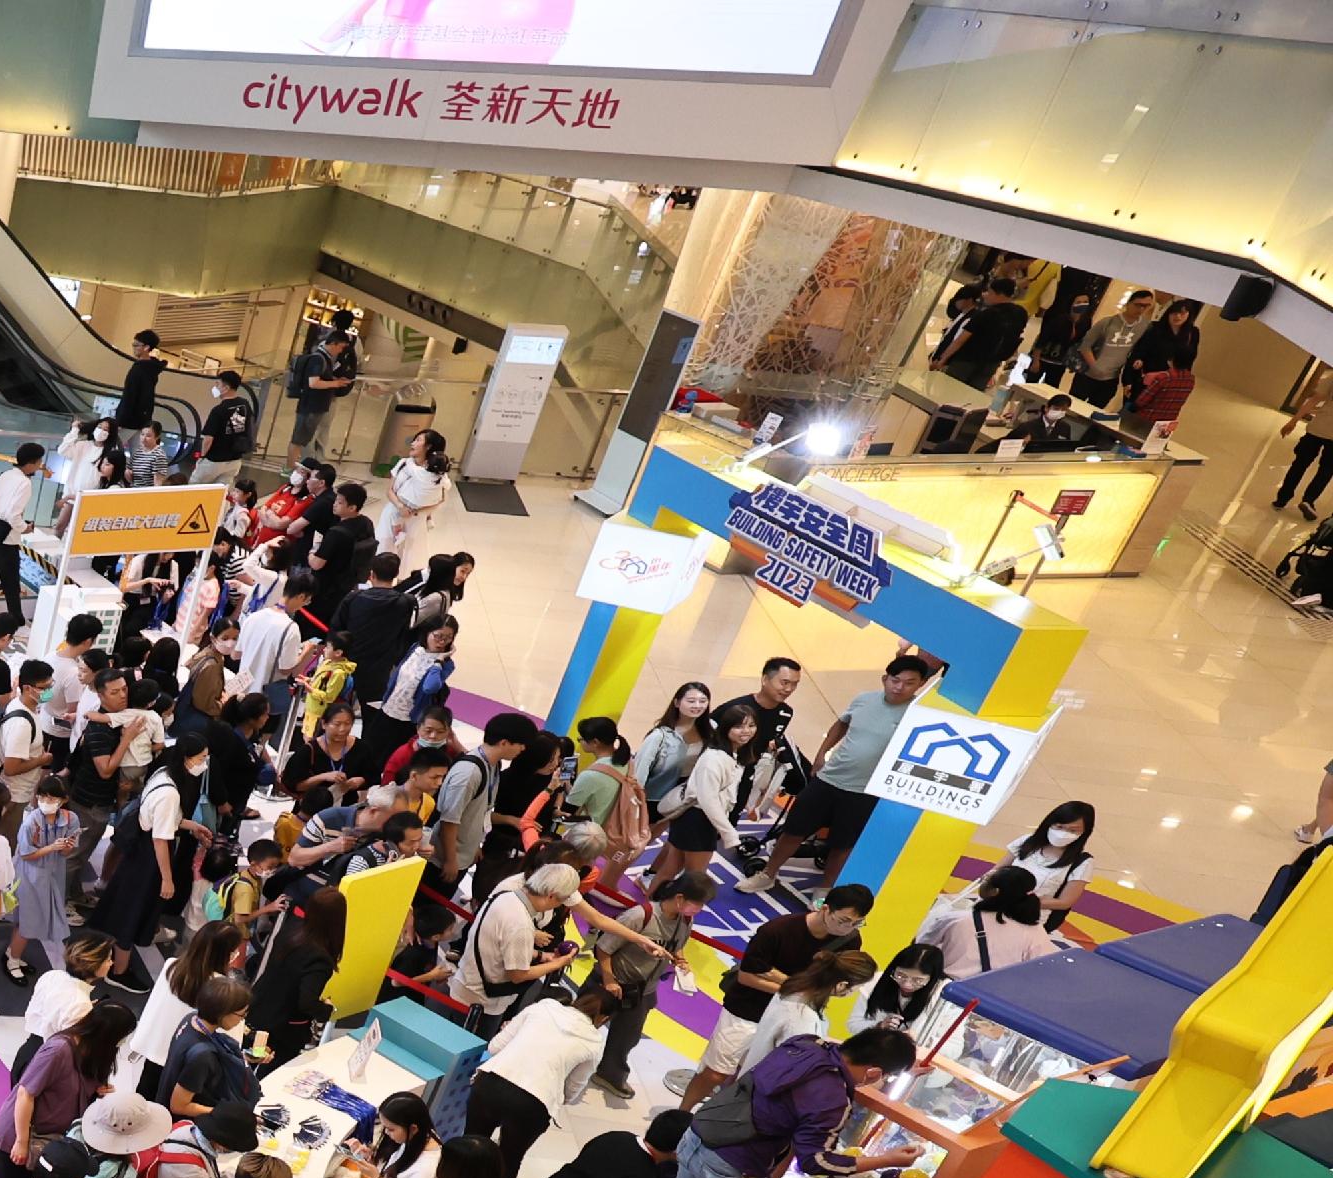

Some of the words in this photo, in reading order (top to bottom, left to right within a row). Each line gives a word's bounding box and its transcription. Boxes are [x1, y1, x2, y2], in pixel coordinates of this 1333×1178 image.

[242, 73, 424, 124] citywalk
[439, 80, 621, 130] 荃新天地
[754, 483, 875, 564] 樓宇安全周
[728, 508, 786, 550] BUILDING
[784, 537, 837, 578] SAFETY
[835, 560, 879, 601] WEEK
[757, 555, 815, 602] 2023
[884, 774, 983, 809] BUILDINGS
[886, 786, 971, 815] DEPARTMENT
